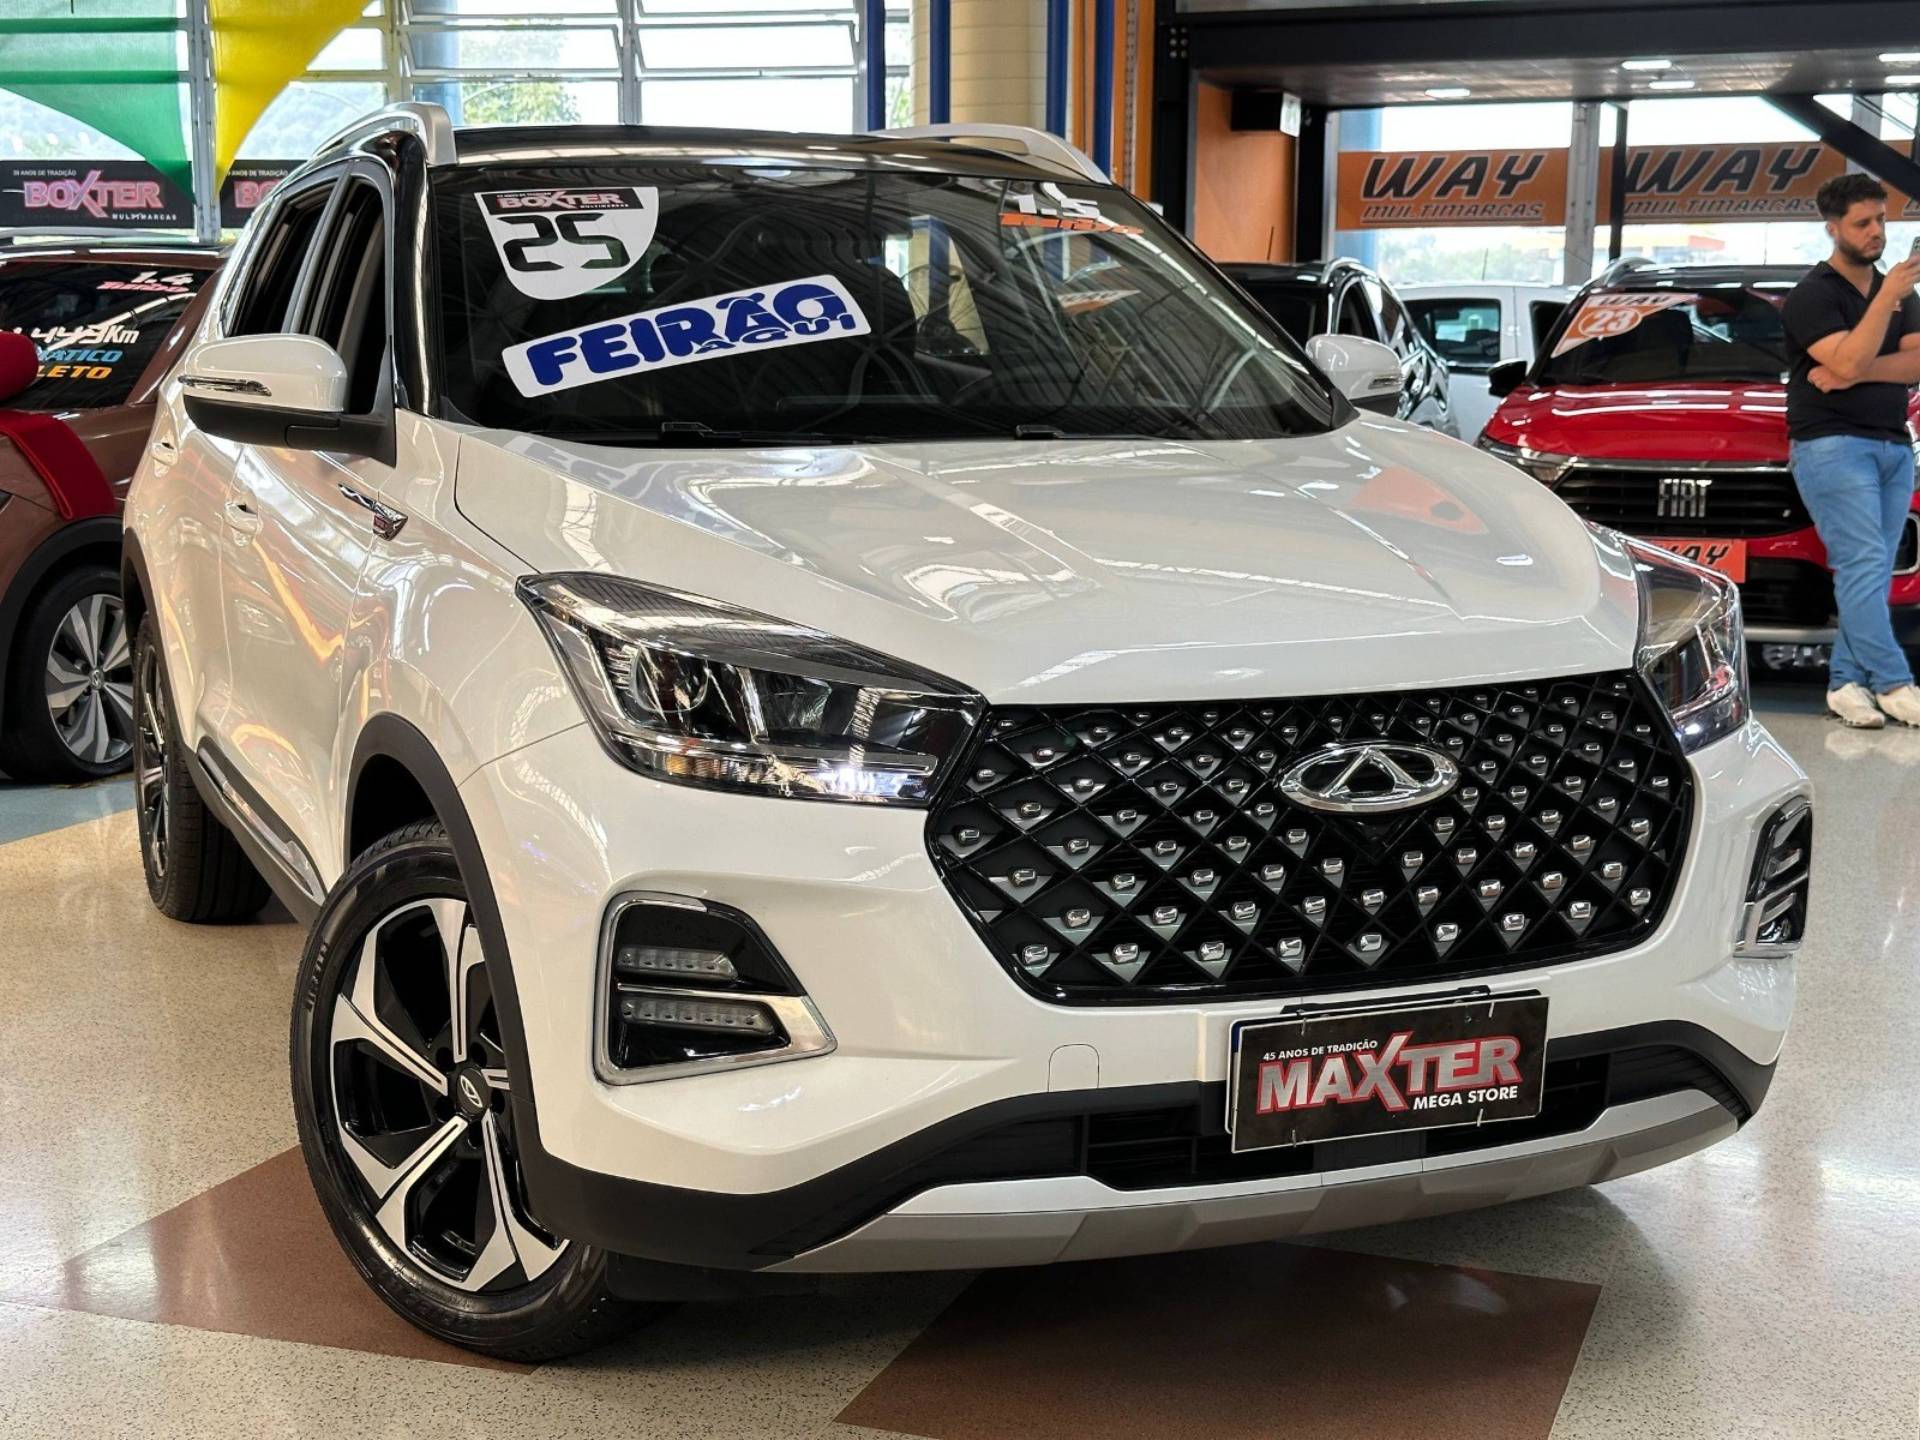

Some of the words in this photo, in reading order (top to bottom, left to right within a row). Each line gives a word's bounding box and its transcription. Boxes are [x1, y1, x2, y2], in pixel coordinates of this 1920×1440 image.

[1360, 152, 1546, 200] WAY
[1624, 147, 1824, 195] WAY
[23, 170, 163, 218] BOXTER
[497, 190, 625, 210] BOXTER
[1362, 202, 1544, 220] MULTIMARCAS
[496, 212, 631, 272] 25
[131, 271, 194, 286] 1.4
[526, 283, 848, 387] FEIRÃO
[692, 313, 857, 355] AQUI
[1586, 309, 1632, 335] 23
[1657, 477, 1713, 518] FIAT
[1263, 1051, 1277, 1061] 45
[1278, 1048, 1310, 1060] ANOS
[1311, 1046, 1325, 1056] DE
[1327, 1039, 1378, 1054] TRADIÇÃO
[1256, 1030, 1523, 1115] MAXTER
[1413, 1092, 1463, 1111] MEGA
[1467, 1085, 1519, 1105] STORE
